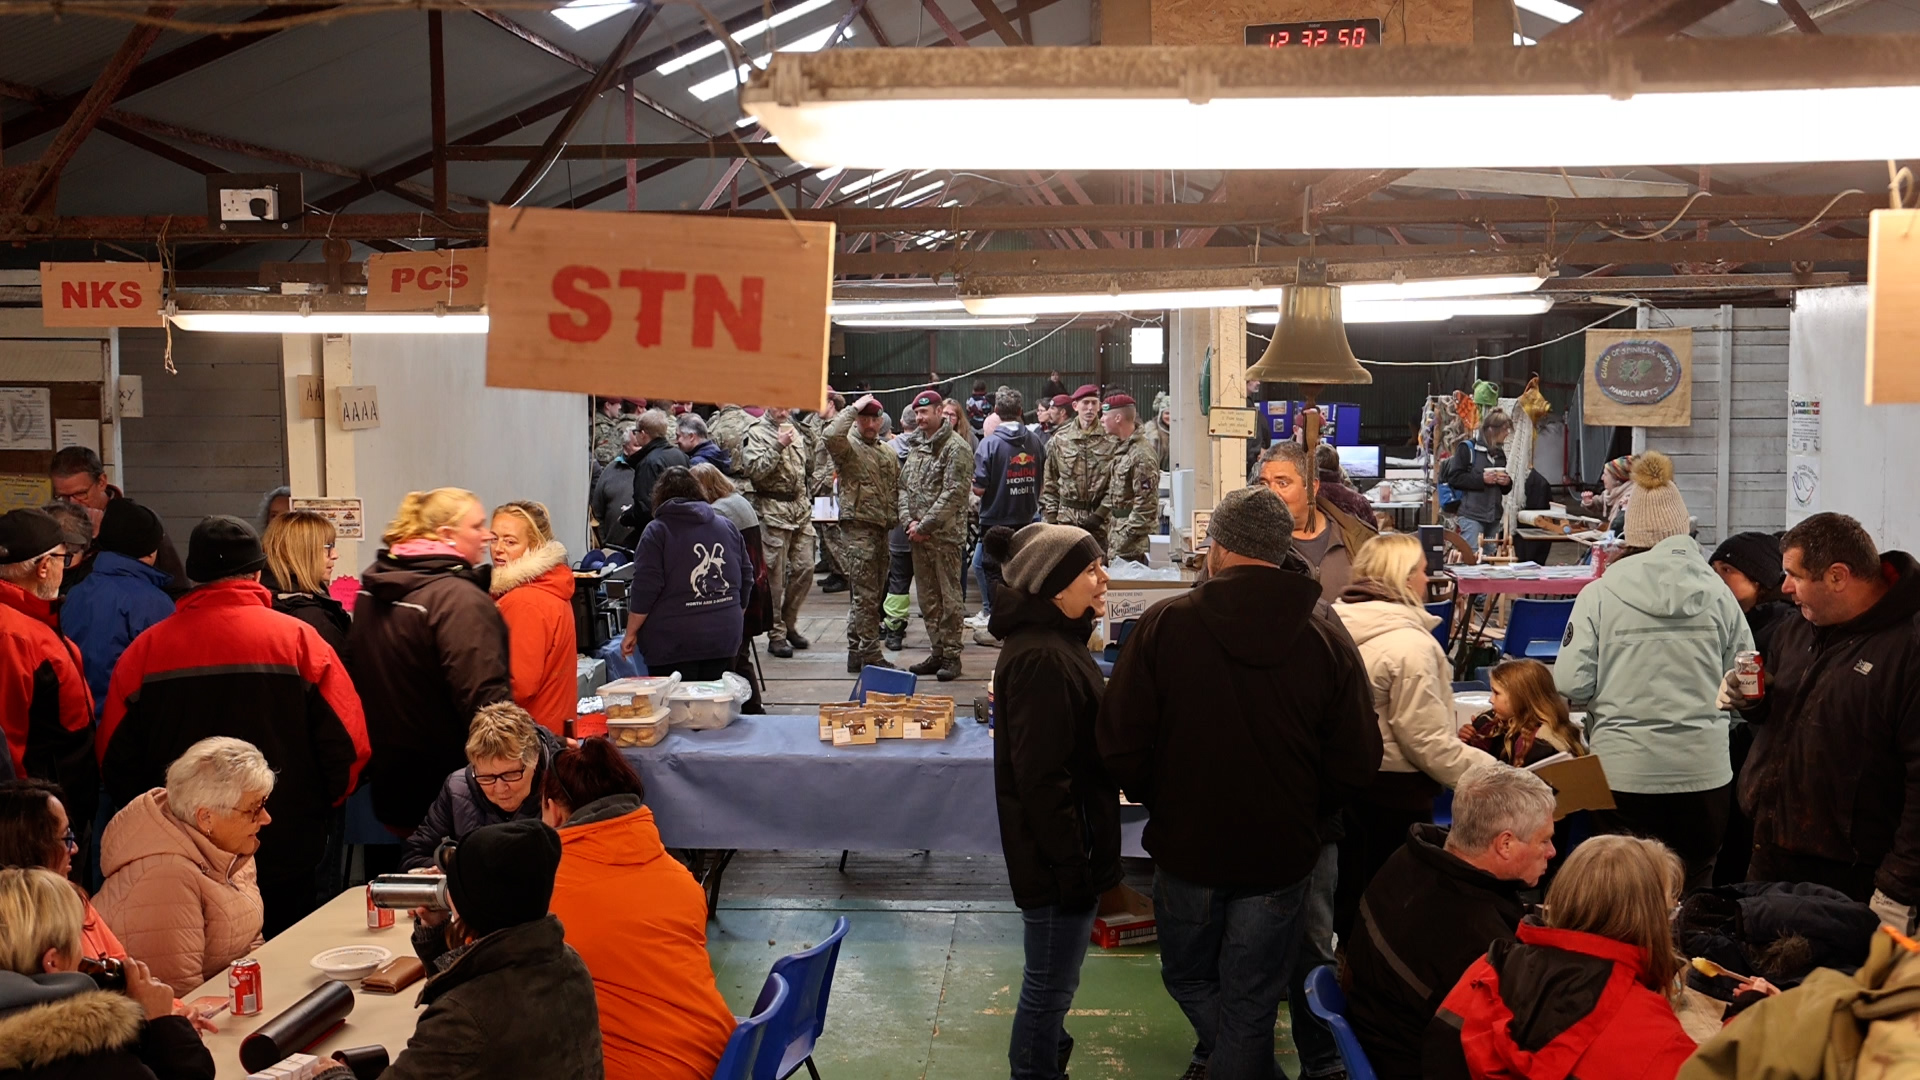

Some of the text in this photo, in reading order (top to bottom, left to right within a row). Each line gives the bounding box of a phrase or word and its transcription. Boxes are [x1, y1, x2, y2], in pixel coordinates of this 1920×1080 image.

[1269, 27, 1366, 48] 12 32 50
[391, 264, 468, 293] PCS
[63, 282, 141, 308] NKS
[549, 267, 765, 352] STN
[1611, 347, 1620, 357] OF
[343, 400, 379, 422] AAAA
[1111, 603, 1144, 617] Kingsmill
